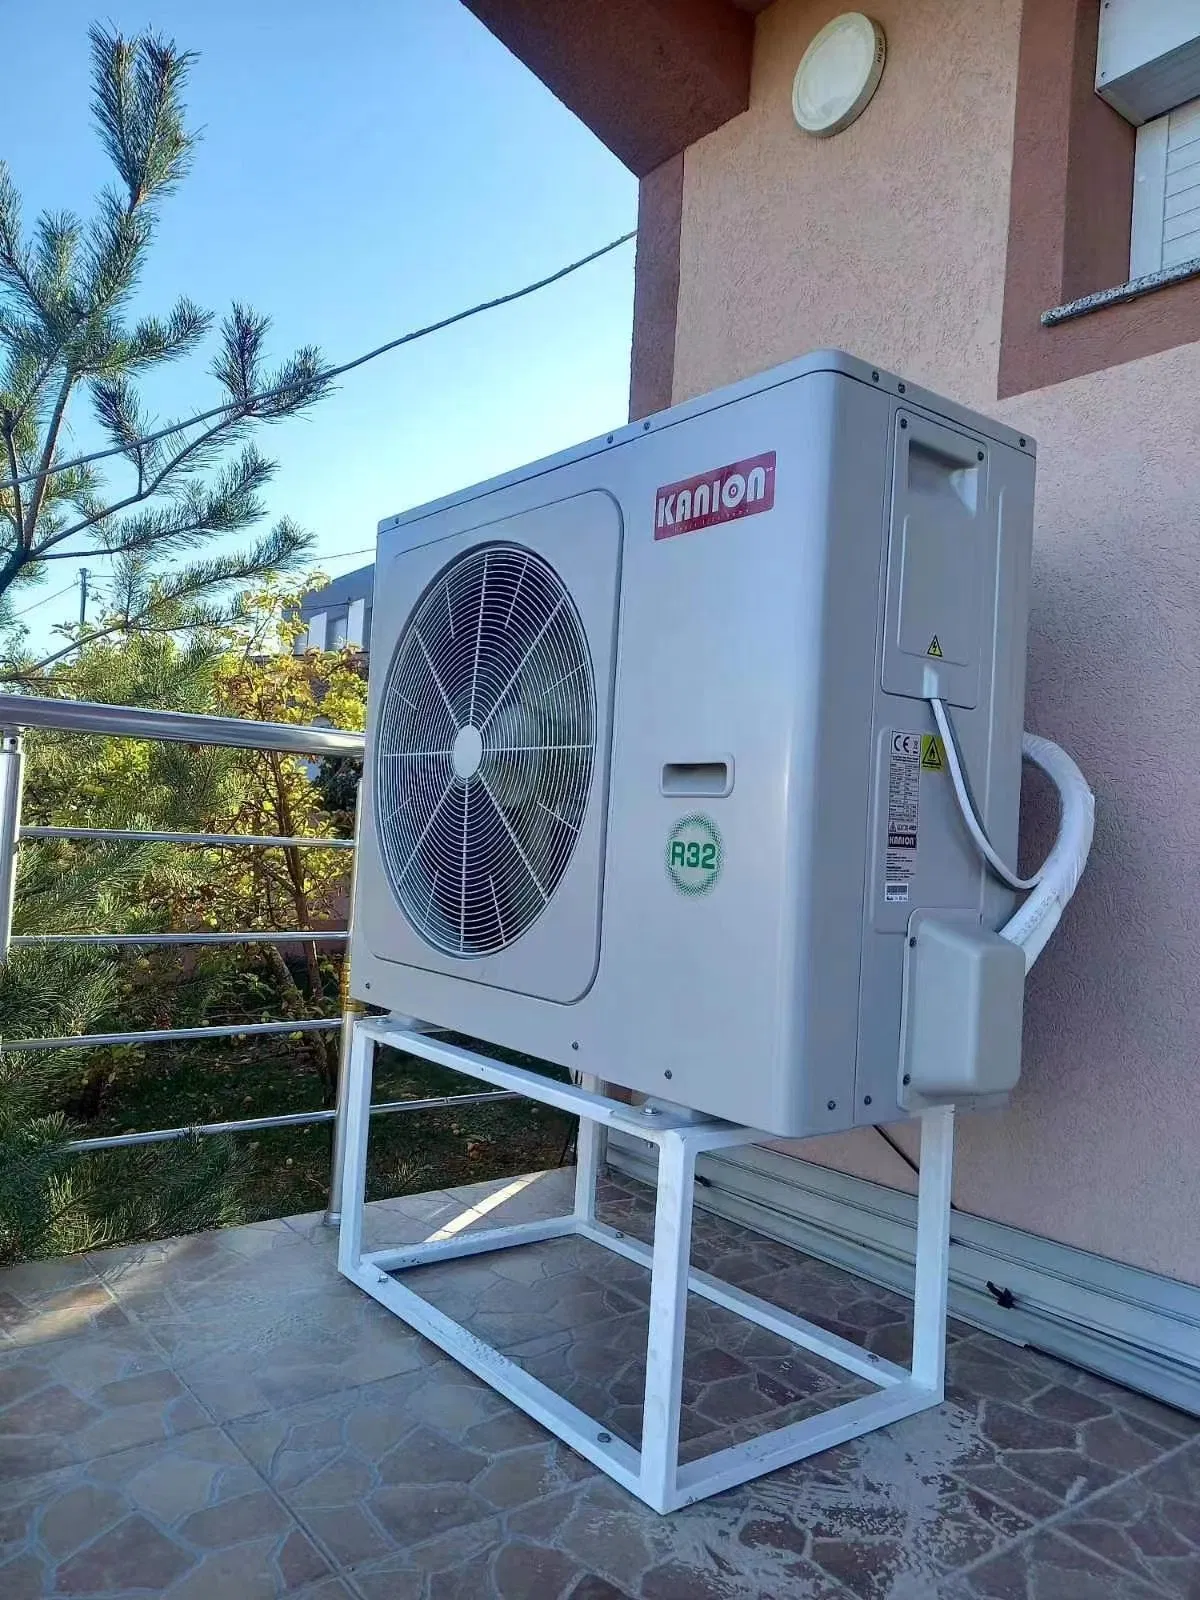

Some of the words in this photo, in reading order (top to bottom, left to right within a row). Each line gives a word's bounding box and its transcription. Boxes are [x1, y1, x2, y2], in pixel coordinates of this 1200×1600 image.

[657, 466, 766, 528] KANION
[893, 734, 910, 753] CE
[671, 841, 716, 870] R32
